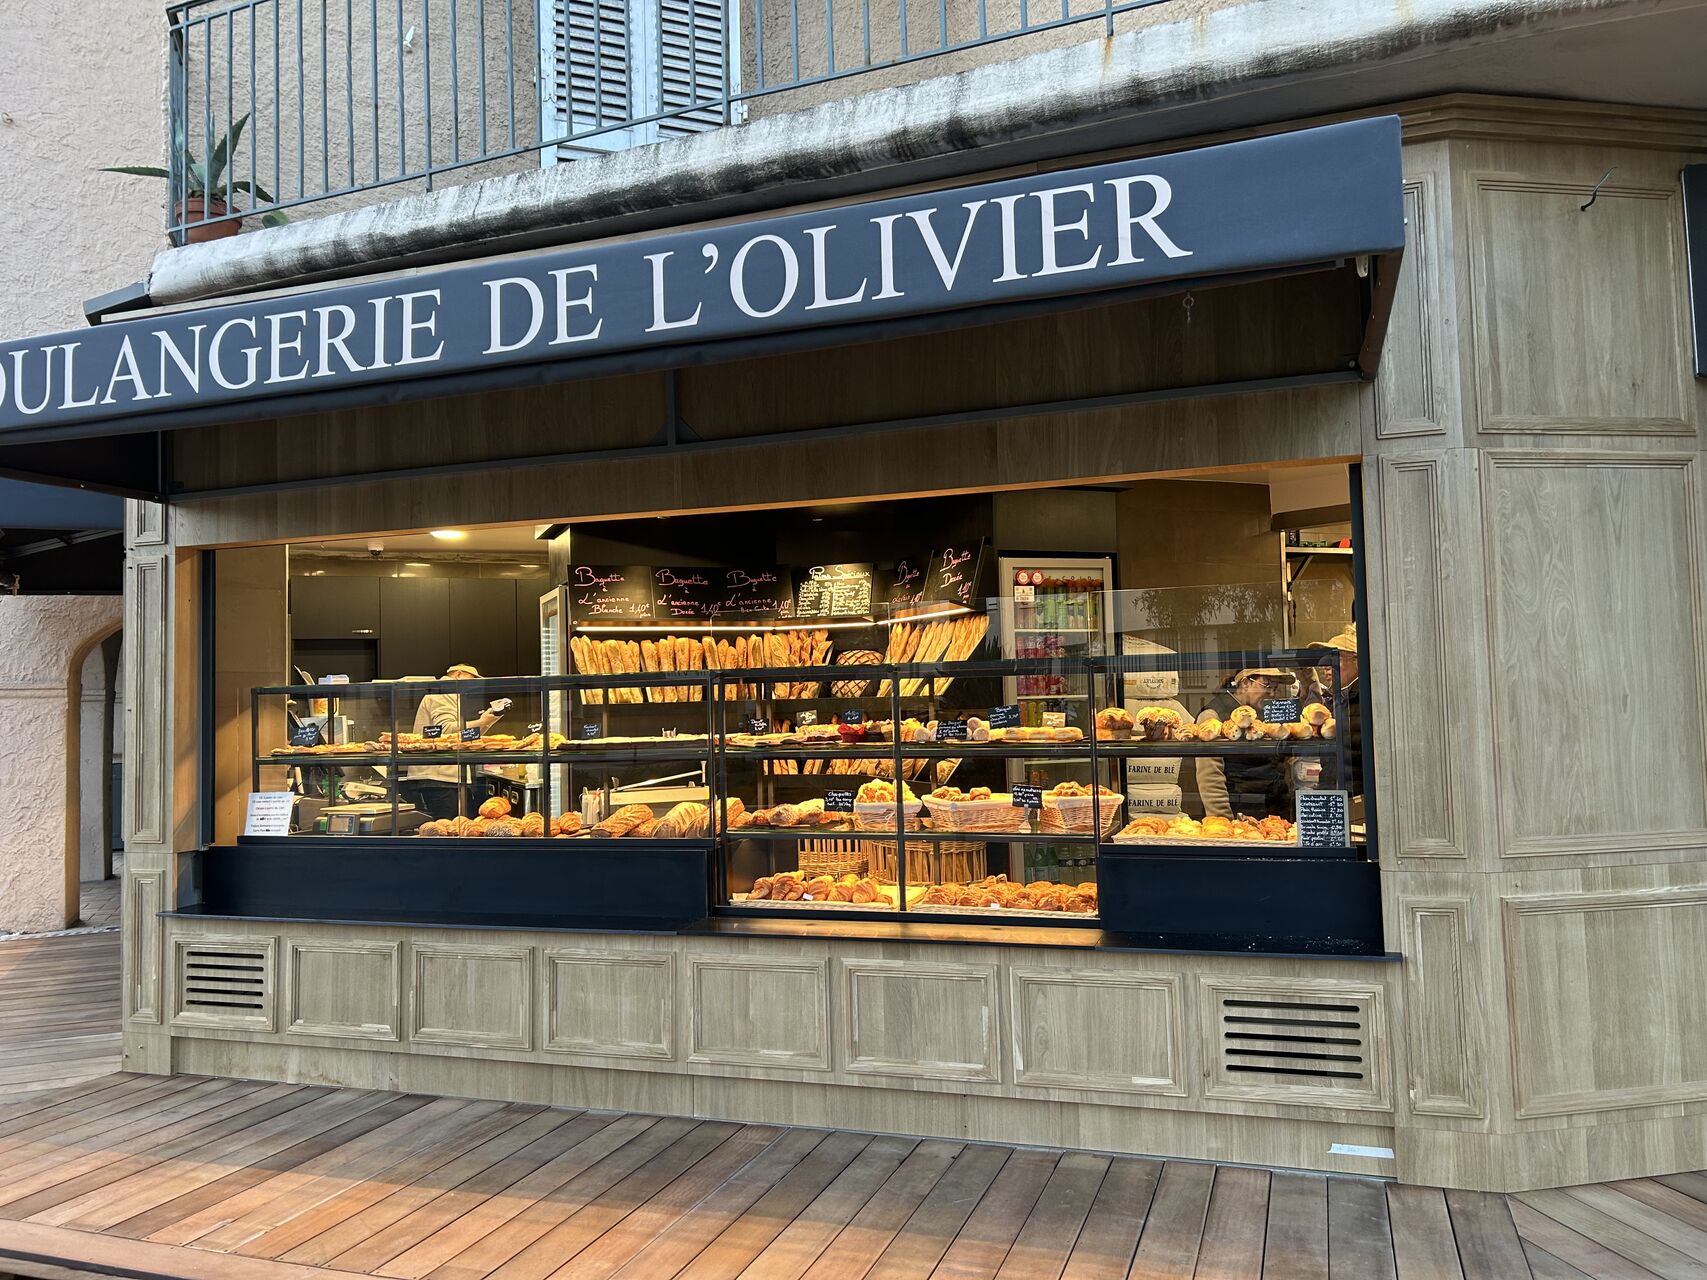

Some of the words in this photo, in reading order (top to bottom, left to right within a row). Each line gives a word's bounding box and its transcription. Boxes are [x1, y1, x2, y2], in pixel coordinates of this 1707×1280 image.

[0, 288, 444, 415] ULANGERIE
[482, 263, 602, 356] DE
[643, 174, 1193, 334] L'OLIVIER
[574, 566, 625, 587] Baguette
[655, 568, 709, 587] Baguette
[726, 570, 777, 588] Baguette
[1128, 765, 1151, 773] FARINE
[1164, 764, 1175, 774] BLÉ
[1128, 799, 1153, 807] FARINE
[1156, 799, 1165, 807] DE
[1167, 797, 1178, 807] BLÉ
